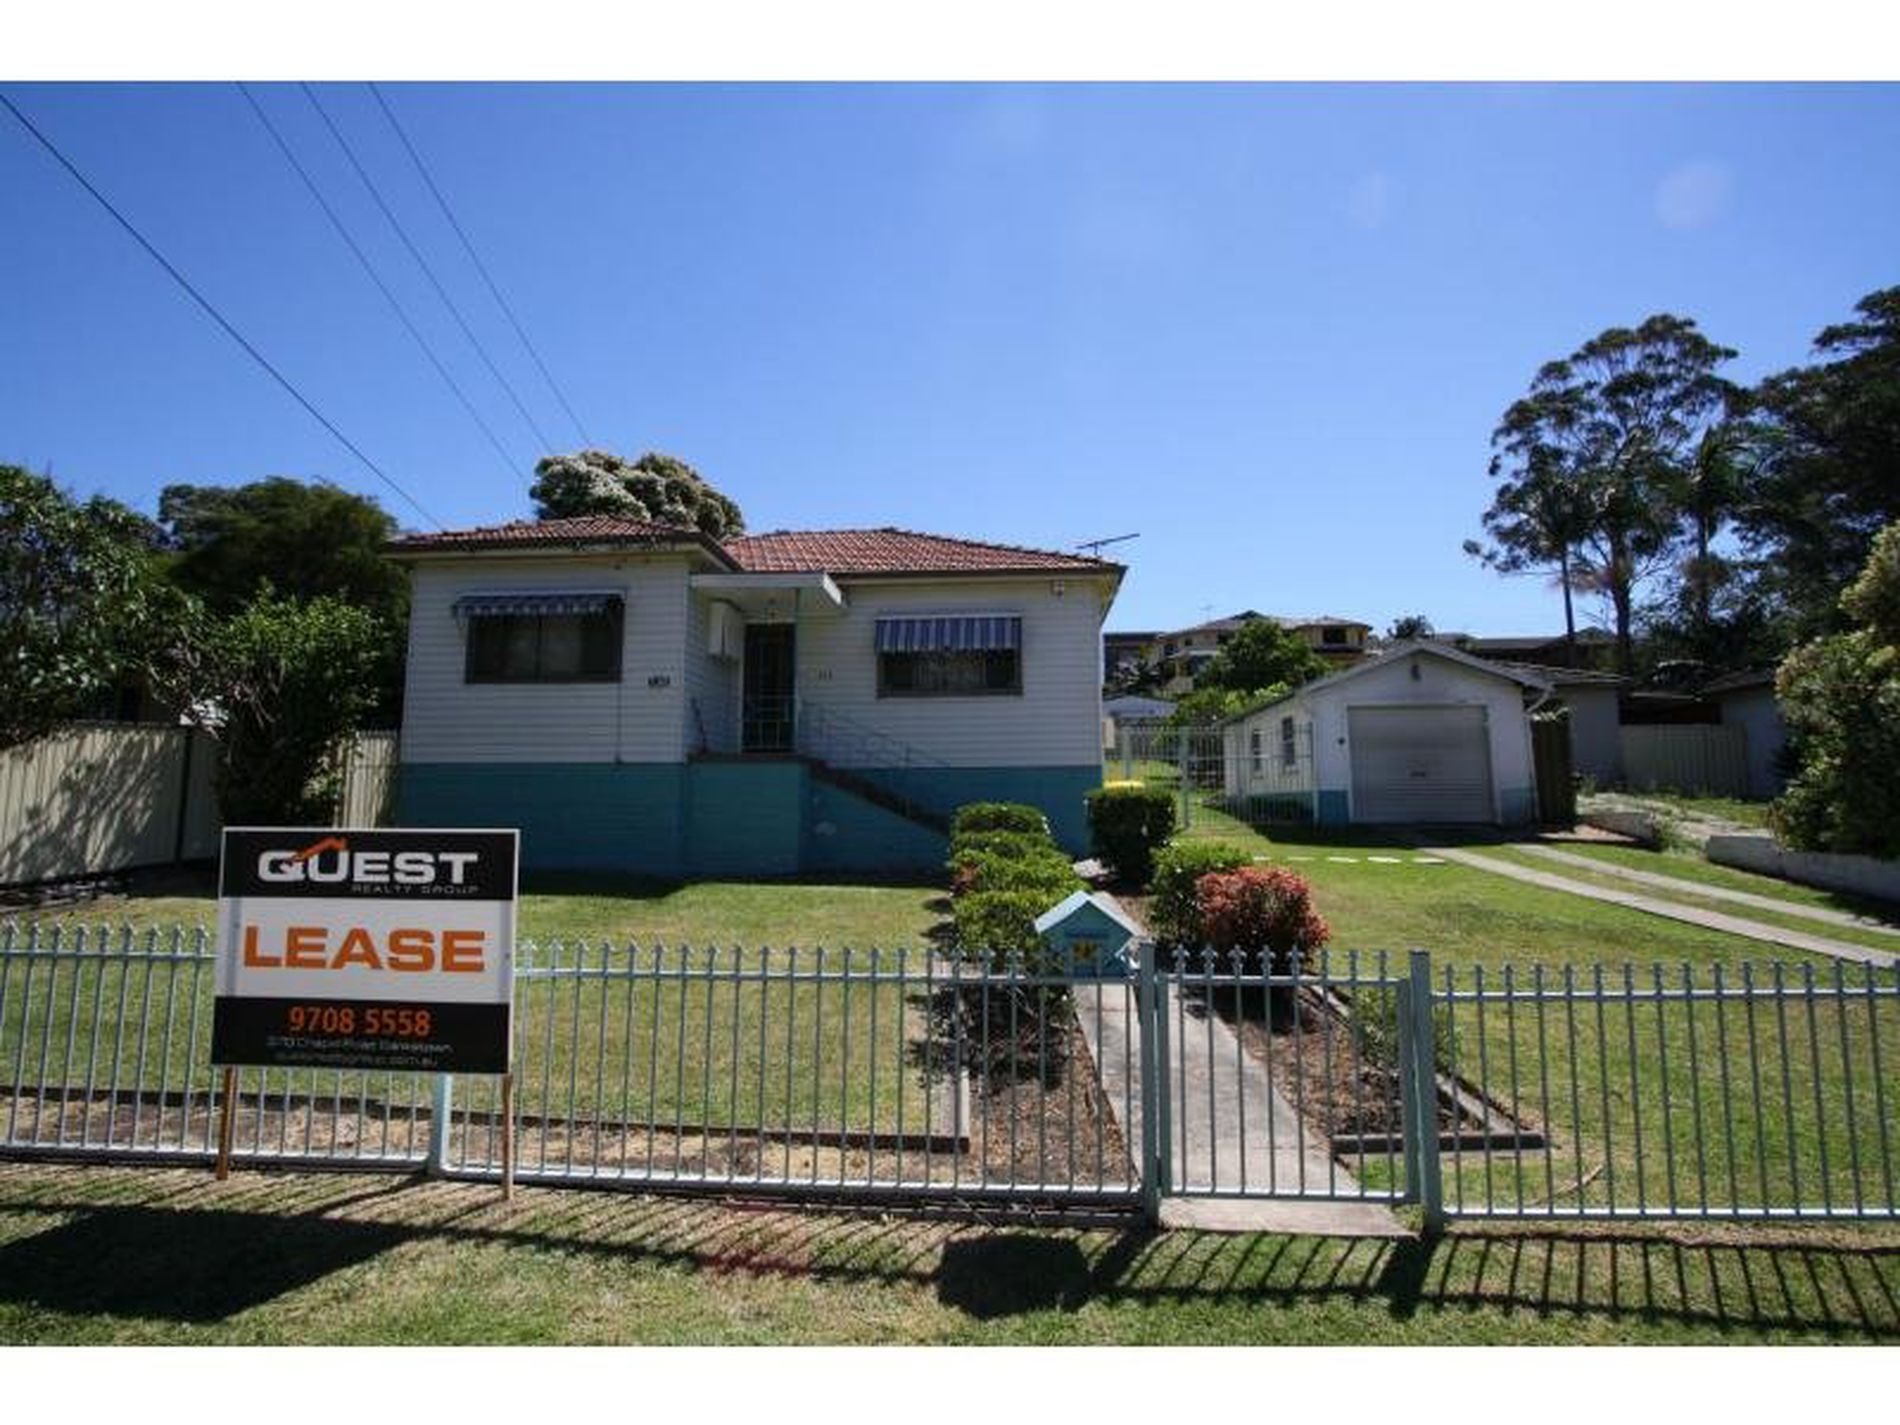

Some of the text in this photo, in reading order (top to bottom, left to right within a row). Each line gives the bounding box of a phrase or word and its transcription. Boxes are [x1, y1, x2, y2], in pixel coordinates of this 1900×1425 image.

[258, 849, 478, 884] QUEST
[352, 884, 479, 894] REALTY GROUP
[244, 926, 485, 972] LEASE
[289, 1006, 431, 1036] 9708 5558
